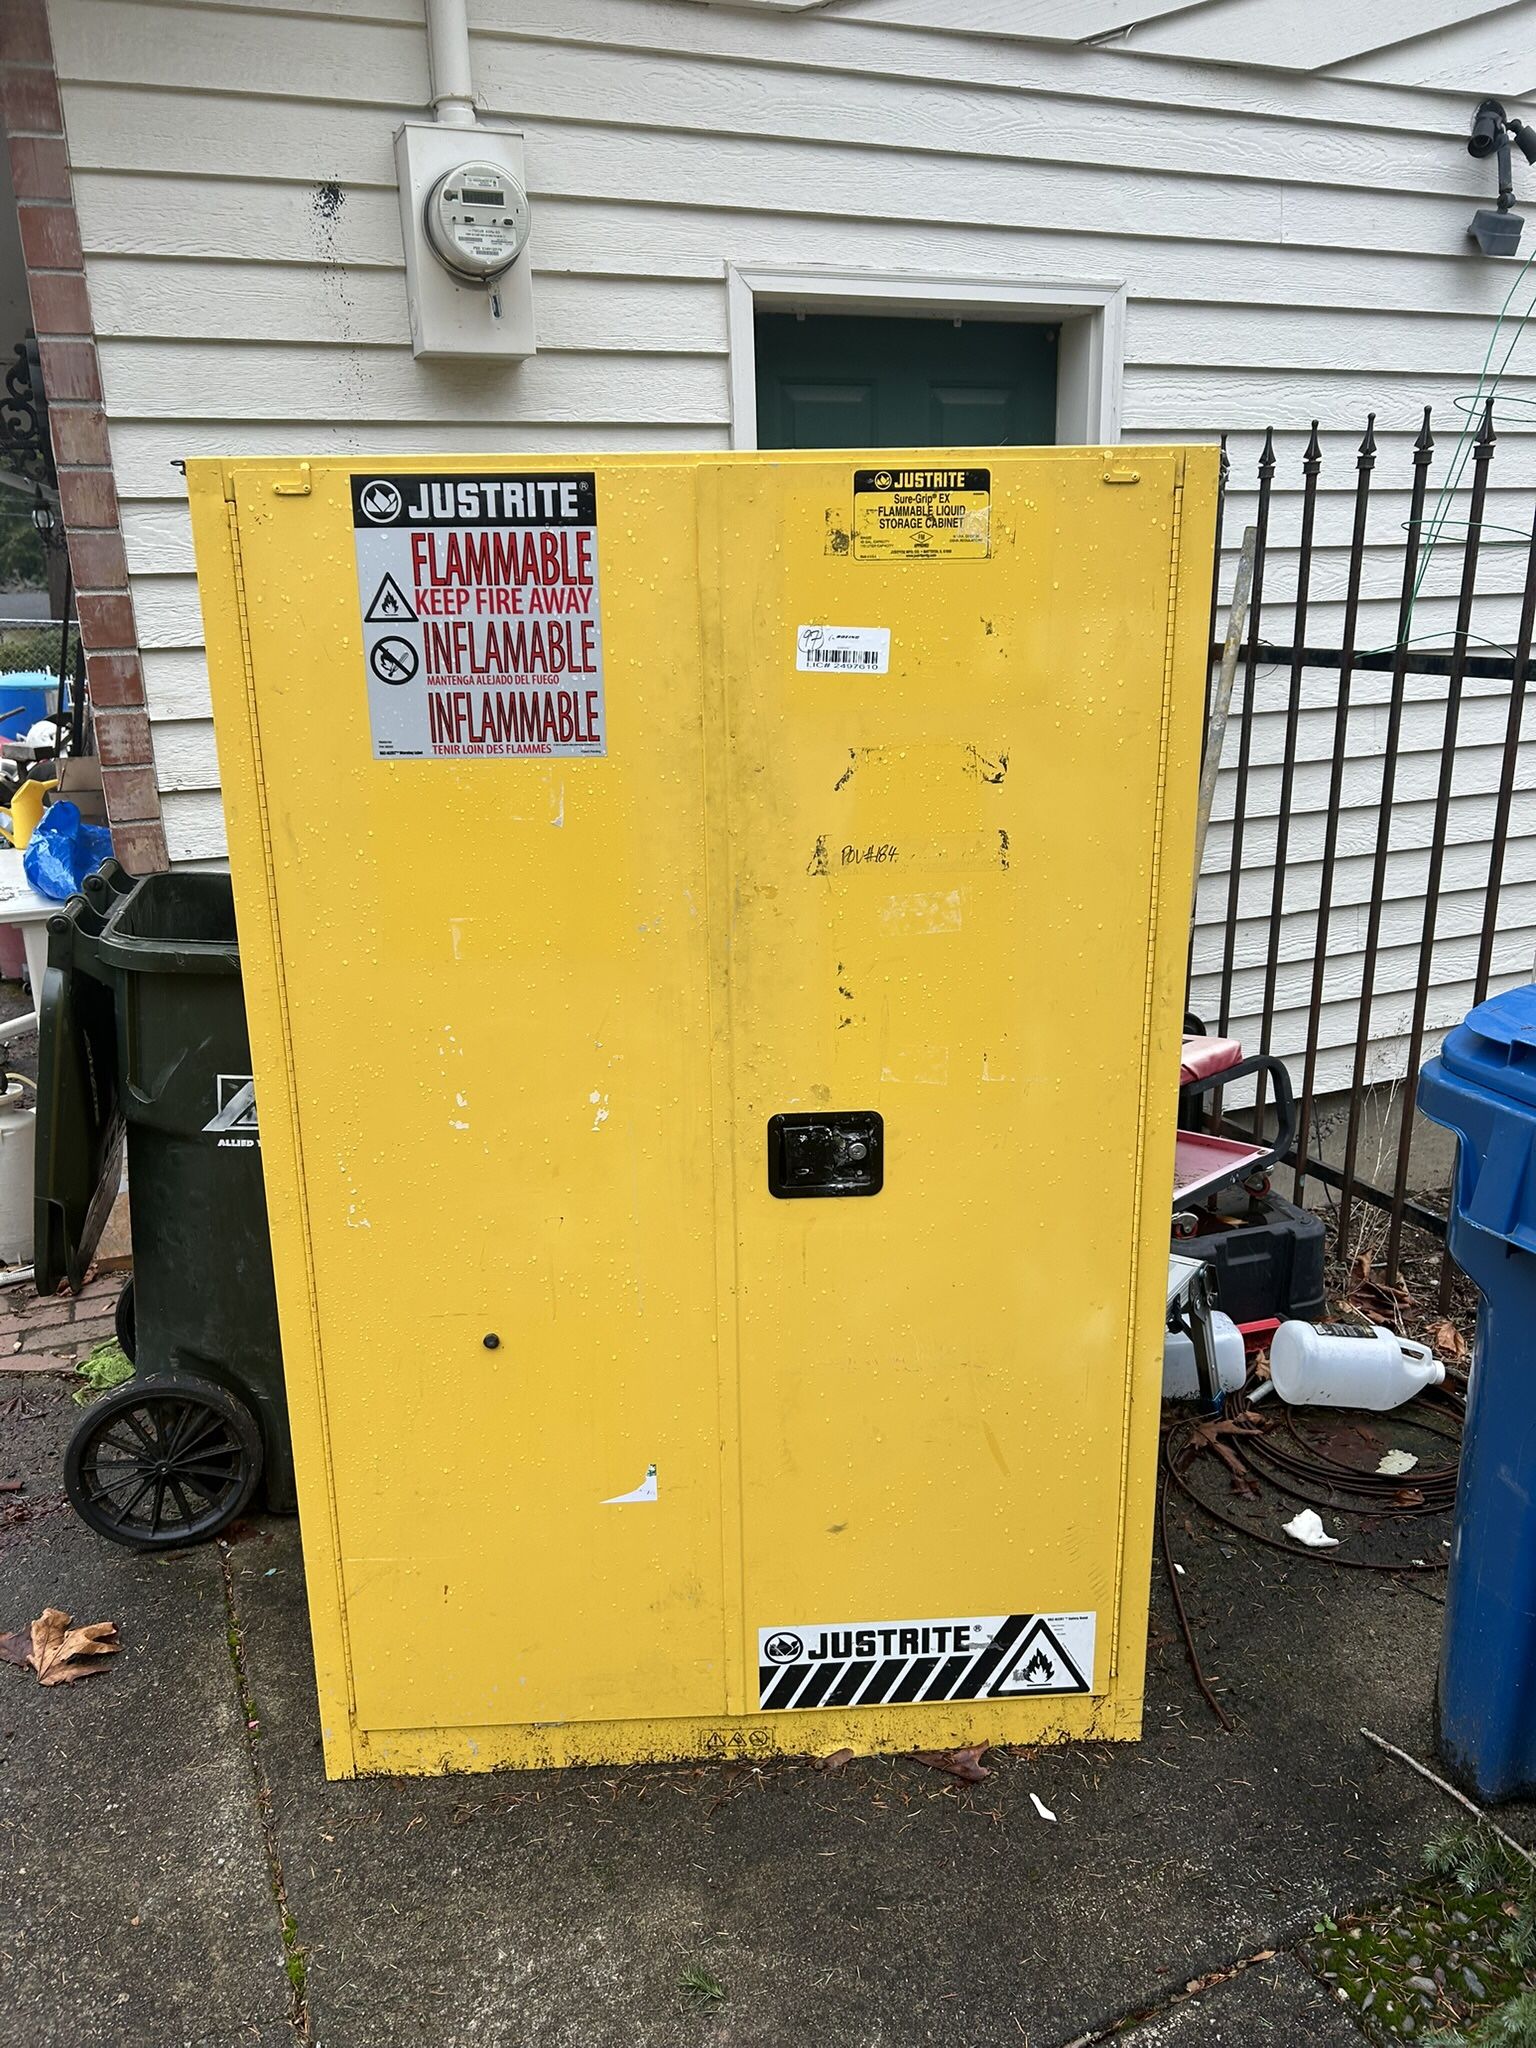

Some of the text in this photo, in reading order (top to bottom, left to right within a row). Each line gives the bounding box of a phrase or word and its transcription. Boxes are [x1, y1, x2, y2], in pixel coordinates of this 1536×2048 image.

[939, 493, 950, 503] EX
[878, 505, 966, 517] FLAMMABLE LIQUID
[879, 517, 964, 529] STORAGE CABINET
[410, 531, 593, 586] FLAMMABLE
[415, 587, 592, 615] KEEP FIRE AWAY
[422, 620, 597, 674] INFLAMABLE
[427, 674, 559, 686] MANTENGA ALEJADO DEL FUEGO
[428, 690, 600, 743] INFLAMMABLE
[433, 743, 552, 754] TENIR LOIN DES FLAMMES
[217, 1139, 254, 1147] ALLIED
